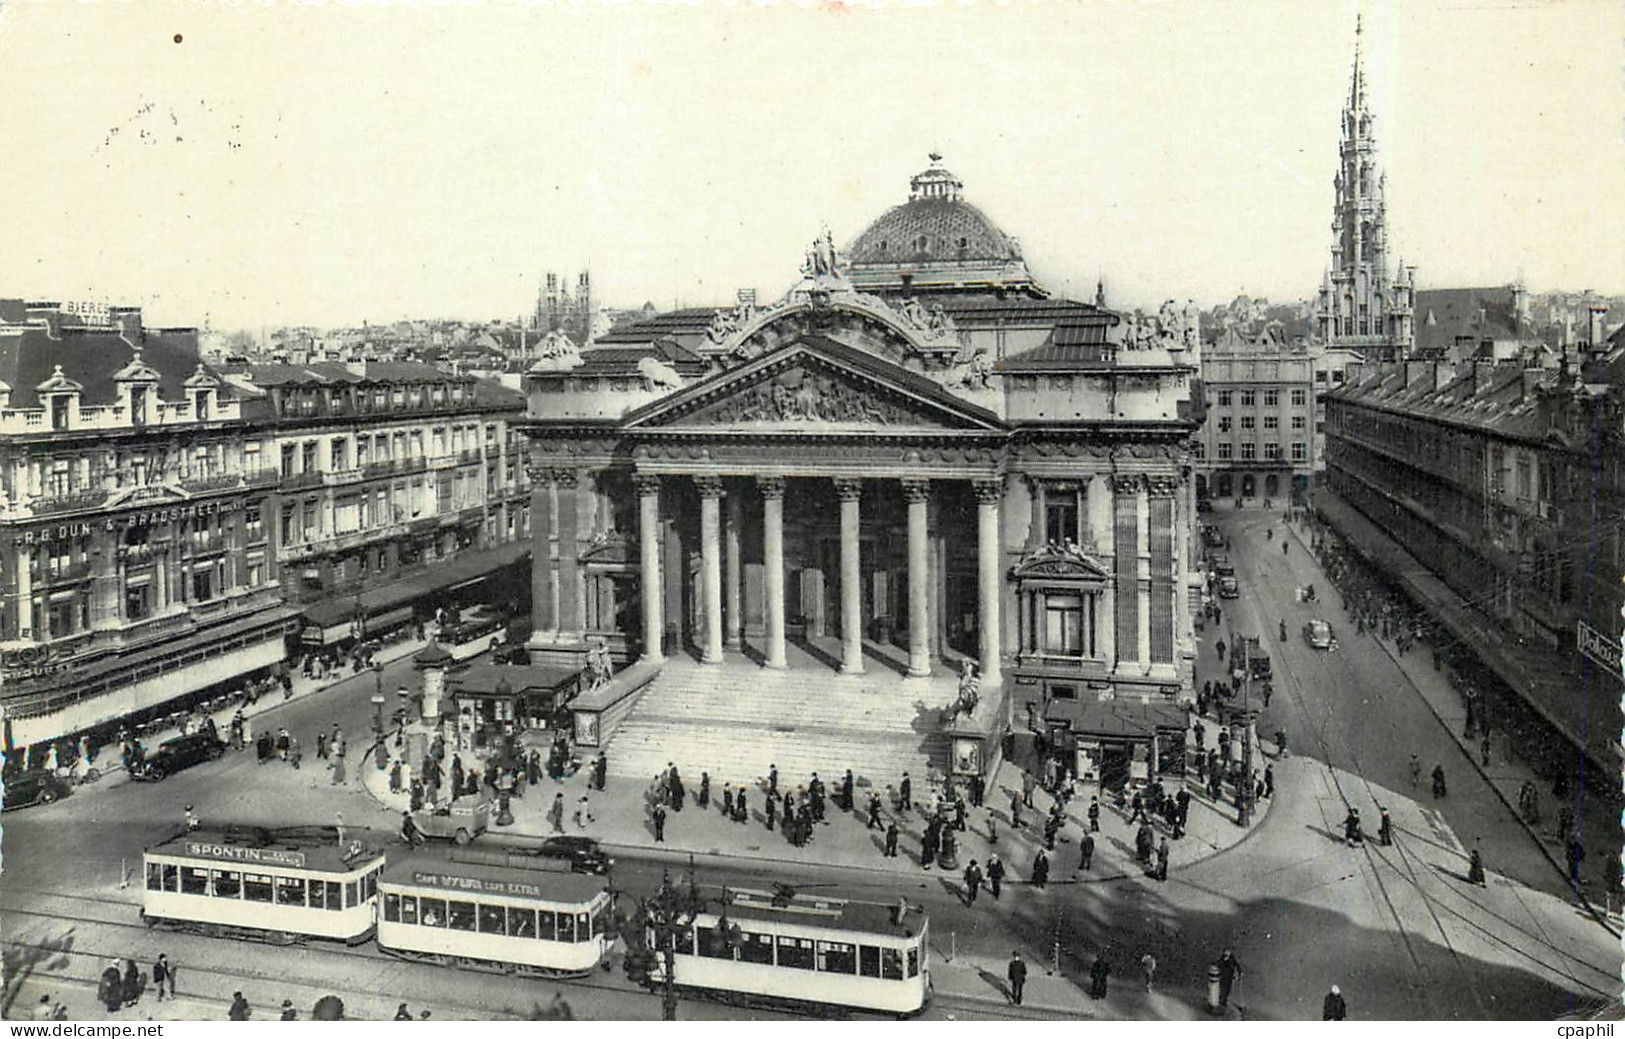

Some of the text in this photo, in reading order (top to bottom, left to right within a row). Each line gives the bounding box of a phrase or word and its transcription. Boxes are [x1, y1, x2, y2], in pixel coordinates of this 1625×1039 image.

[68, 301, 110, 315] BIERES
[59, 523, 90, 539] DUN
[106, 518, 114, 531] &
[191, 843, 260, 860] SPONTIN
